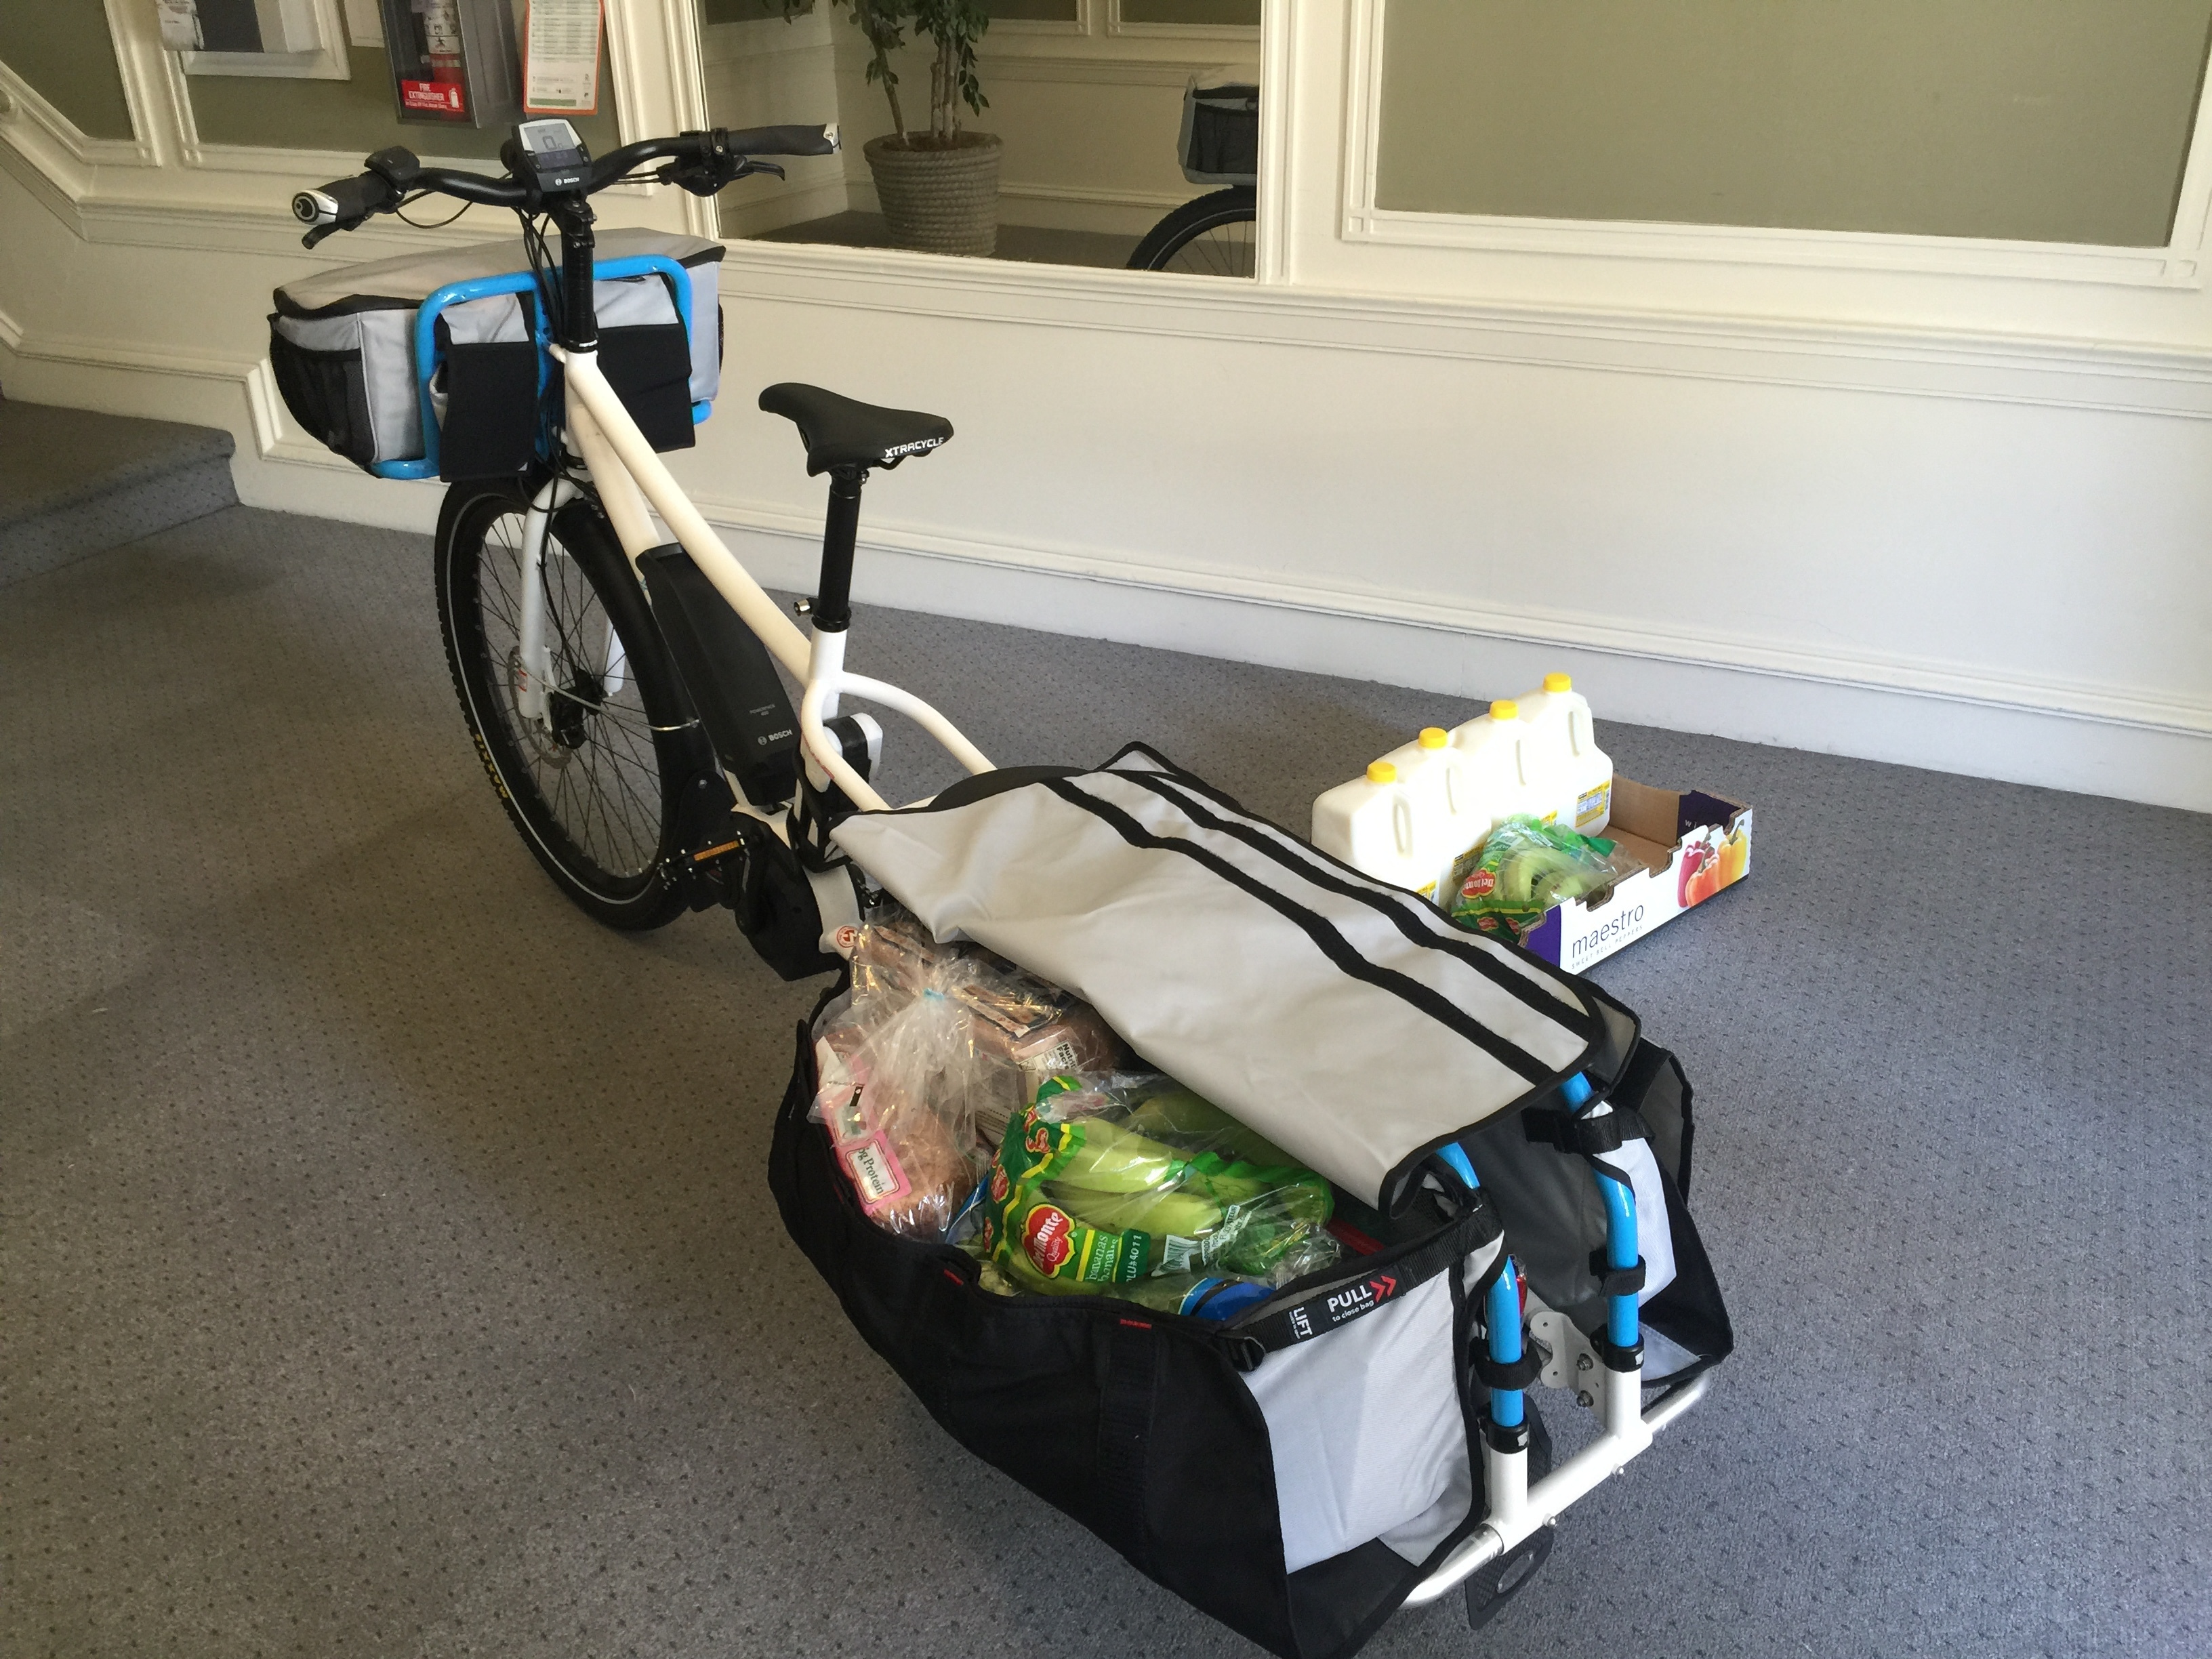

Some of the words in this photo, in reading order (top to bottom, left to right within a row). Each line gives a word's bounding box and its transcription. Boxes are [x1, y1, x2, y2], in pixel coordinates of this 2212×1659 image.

[884, 437, 944, 458] XTRACYCLE
[768, 729, 794, 741] BOSCH
[1572, 905, 1643, 958] maestro
[1572, 953, 1593, 970] SWEET
[1596, 943, 1612, 955] BELL
[1615, 924, 1643, 945] PEPPERS
[863, 1158, 884, 1195] Protein
[1033, 1212, 1063, 1249] Monte
[1046, 1236, 1063, 1262] Quality
[1085, 1234, 1109, 1280] bananas
[1326, 1285, 1372, 1313] PULL
[1341, 1306, 1359, 1319] close
[1360, 1300, 1374, 1310] bag
[1293, 1307, 1313, 1336] LIFT
